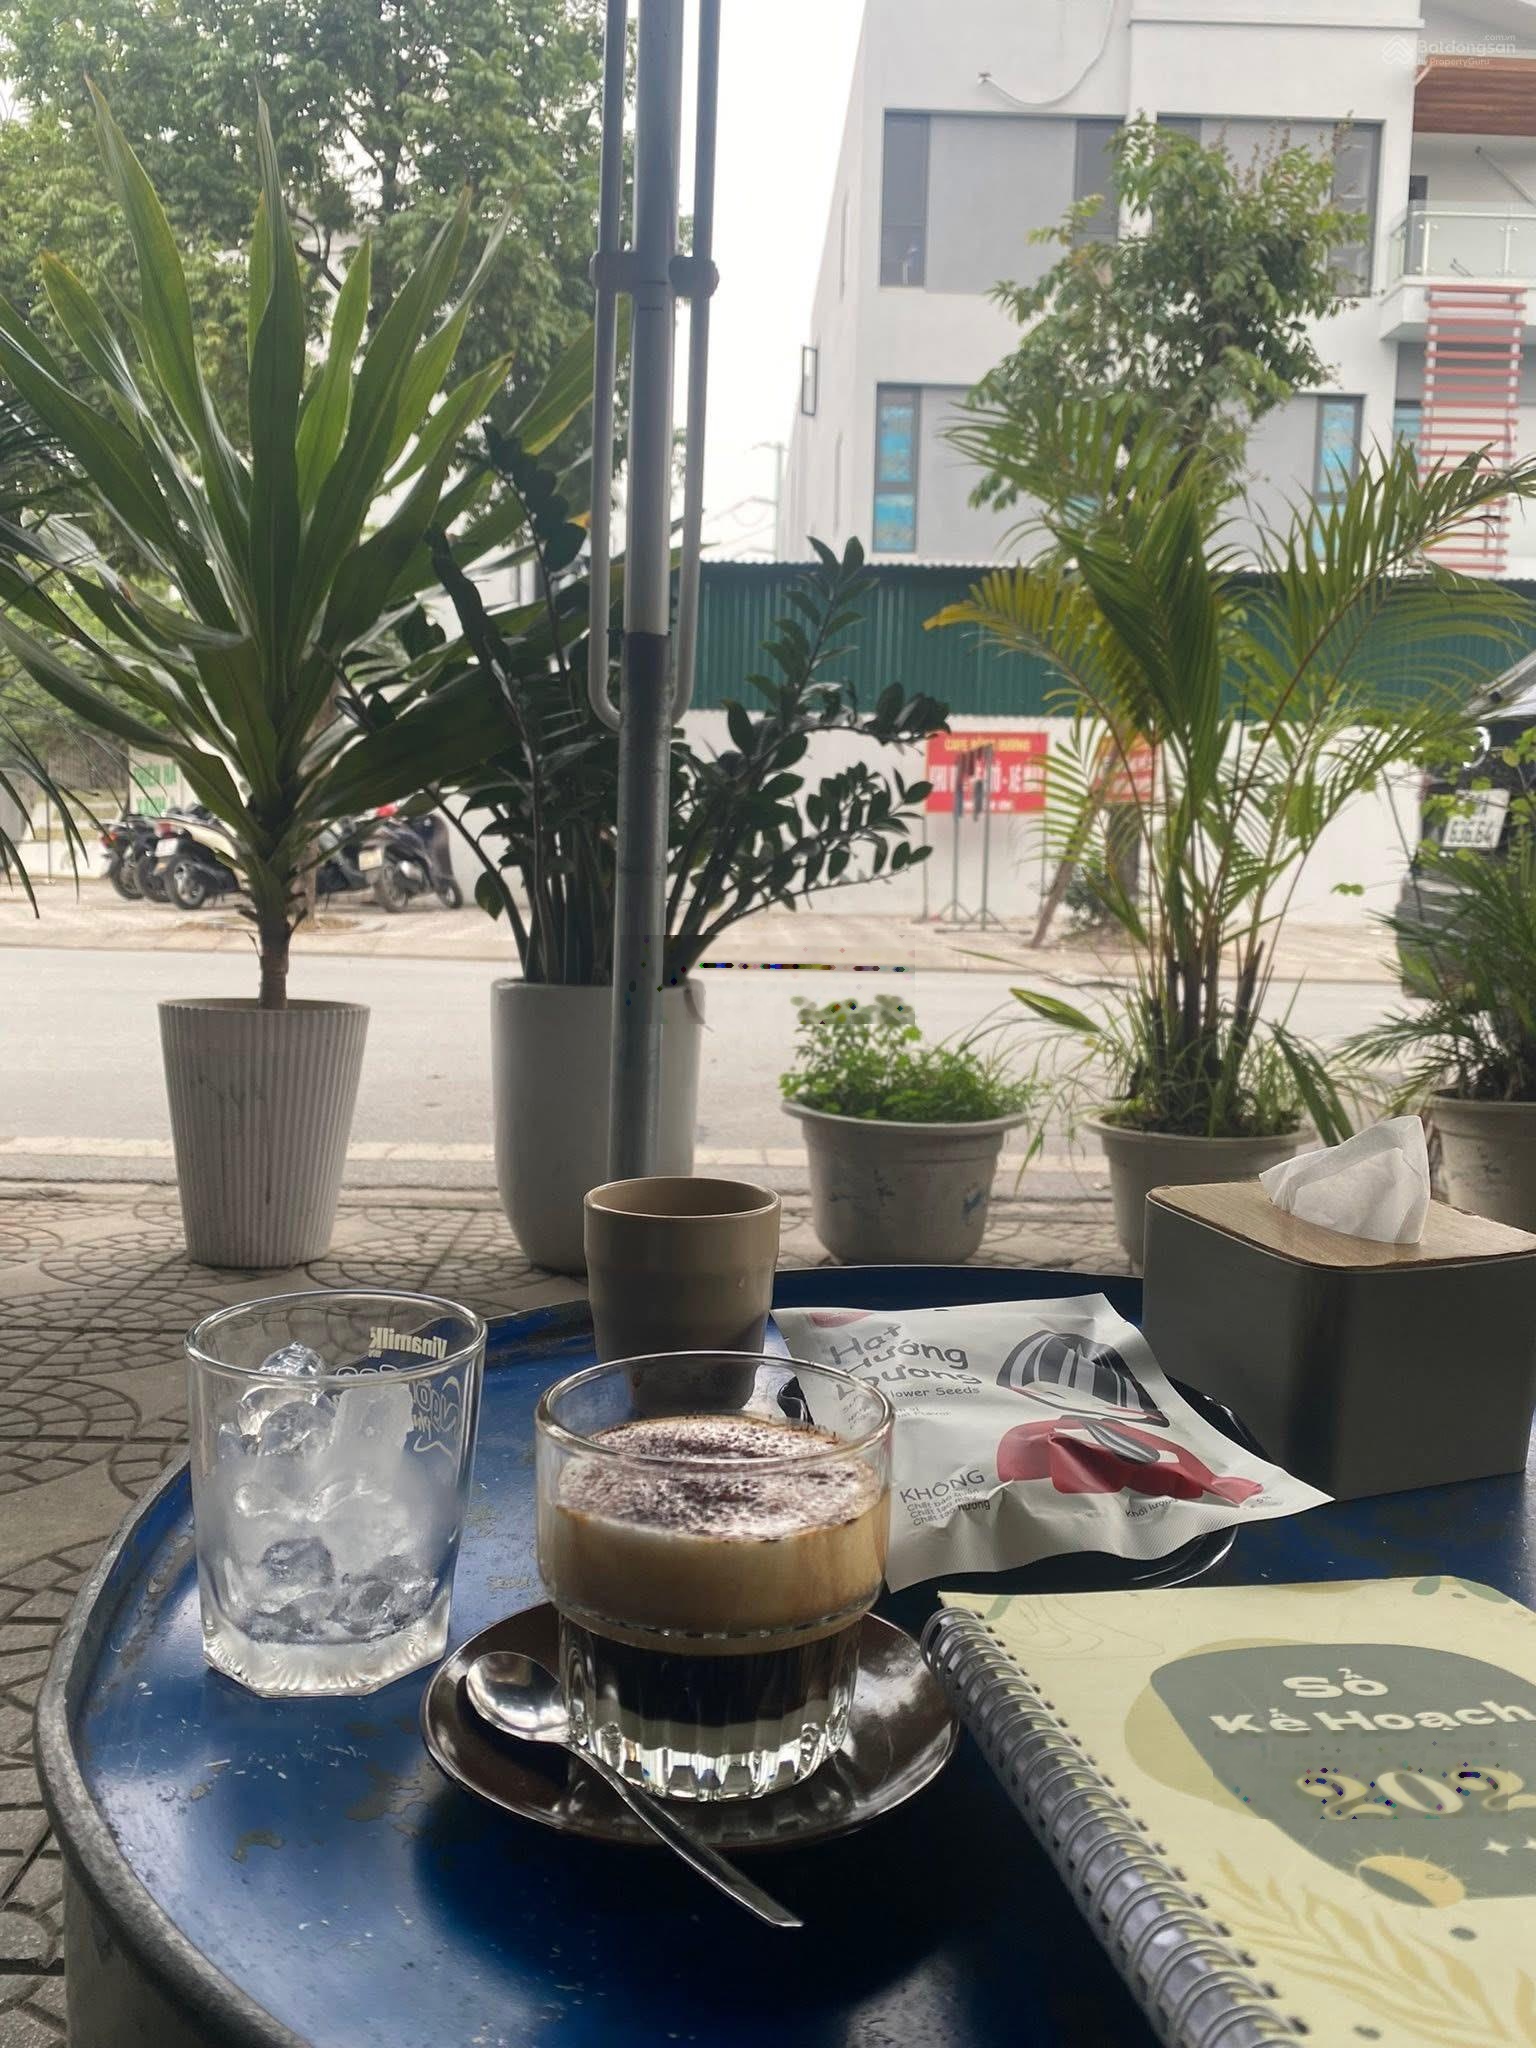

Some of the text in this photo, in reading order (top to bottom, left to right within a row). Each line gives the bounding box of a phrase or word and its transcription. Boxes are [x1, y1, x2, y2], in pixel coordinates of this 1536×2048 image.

[936, 1386, 980, 1396] Seeds
[900, 1469, 985, 1503] KHÔNG
[1282, 1668, 1388, 1698] Sổ
[1209, 1700, 1536, 1734] Kế Hoạch
